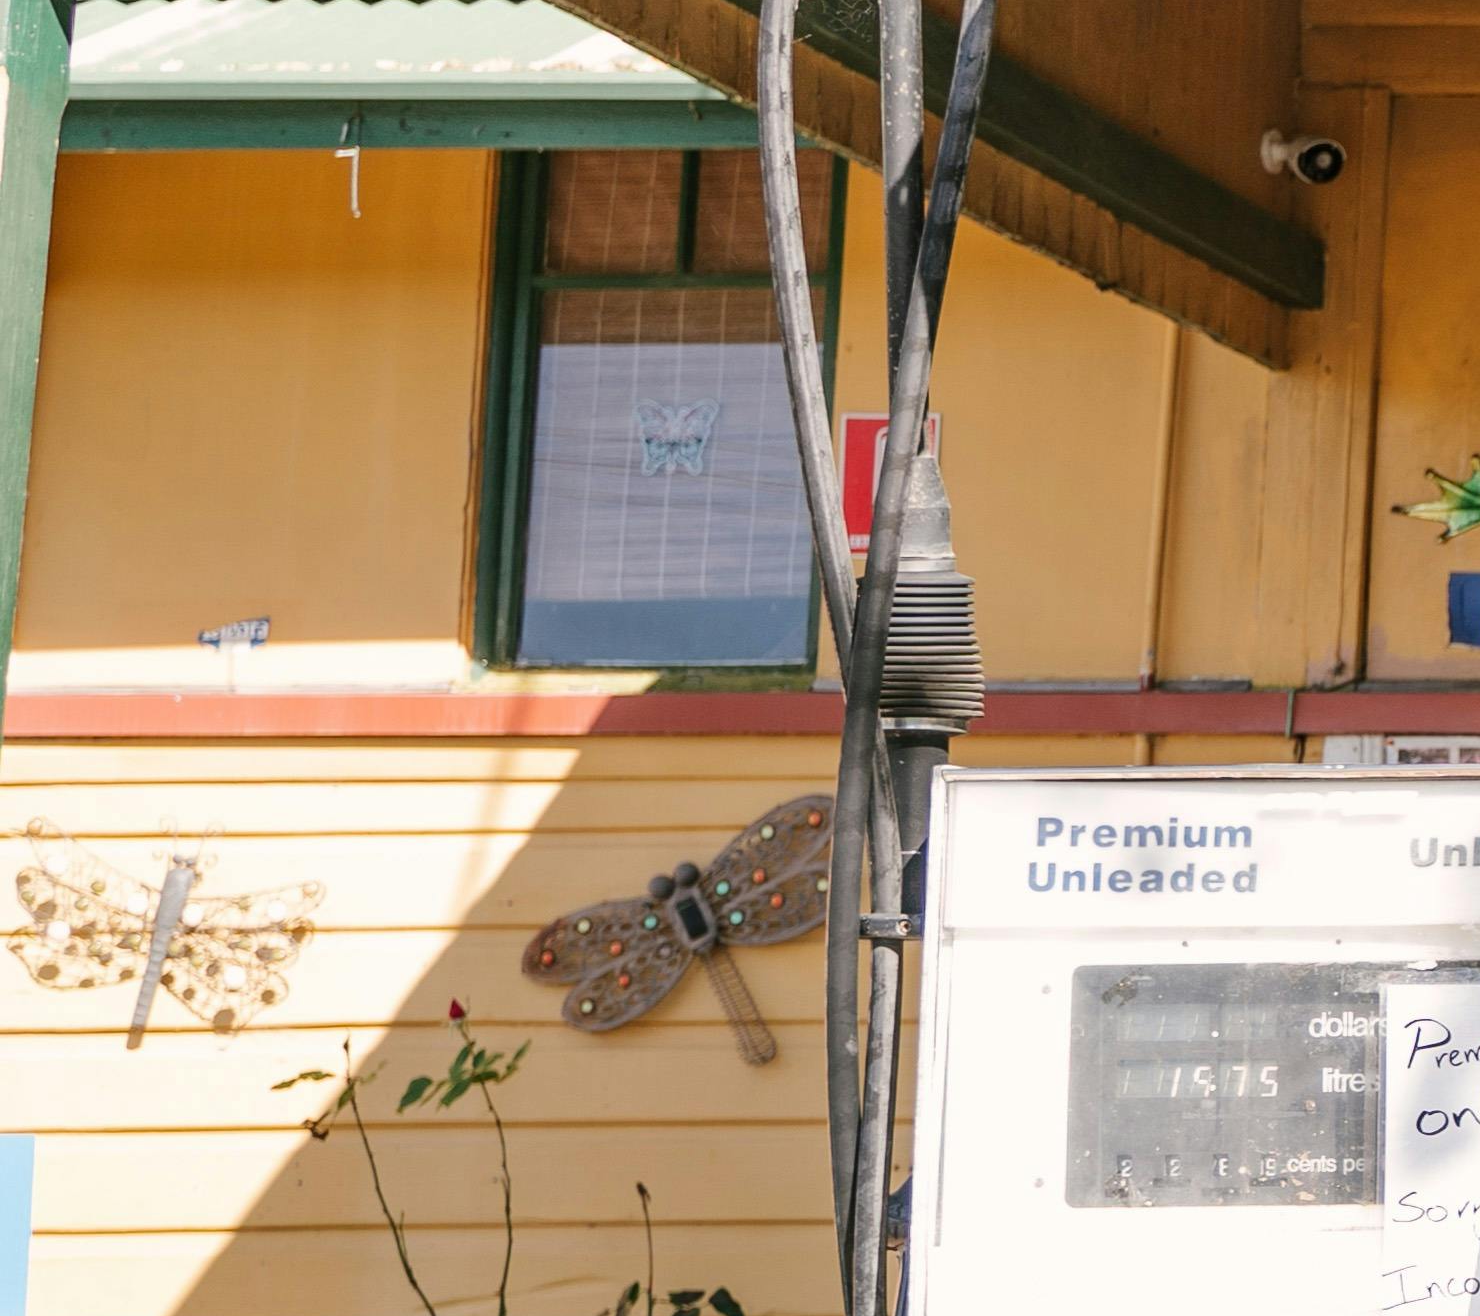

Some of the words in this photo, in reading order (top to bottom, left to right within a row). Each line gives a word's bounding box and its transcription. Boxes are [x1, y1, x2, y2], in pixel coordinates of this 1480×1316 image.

[1036, 816, 1254, 850] Premium
[1028, 860, 1260, 896] Unleaded
[1287, 1157, 1337, 1173] cents
